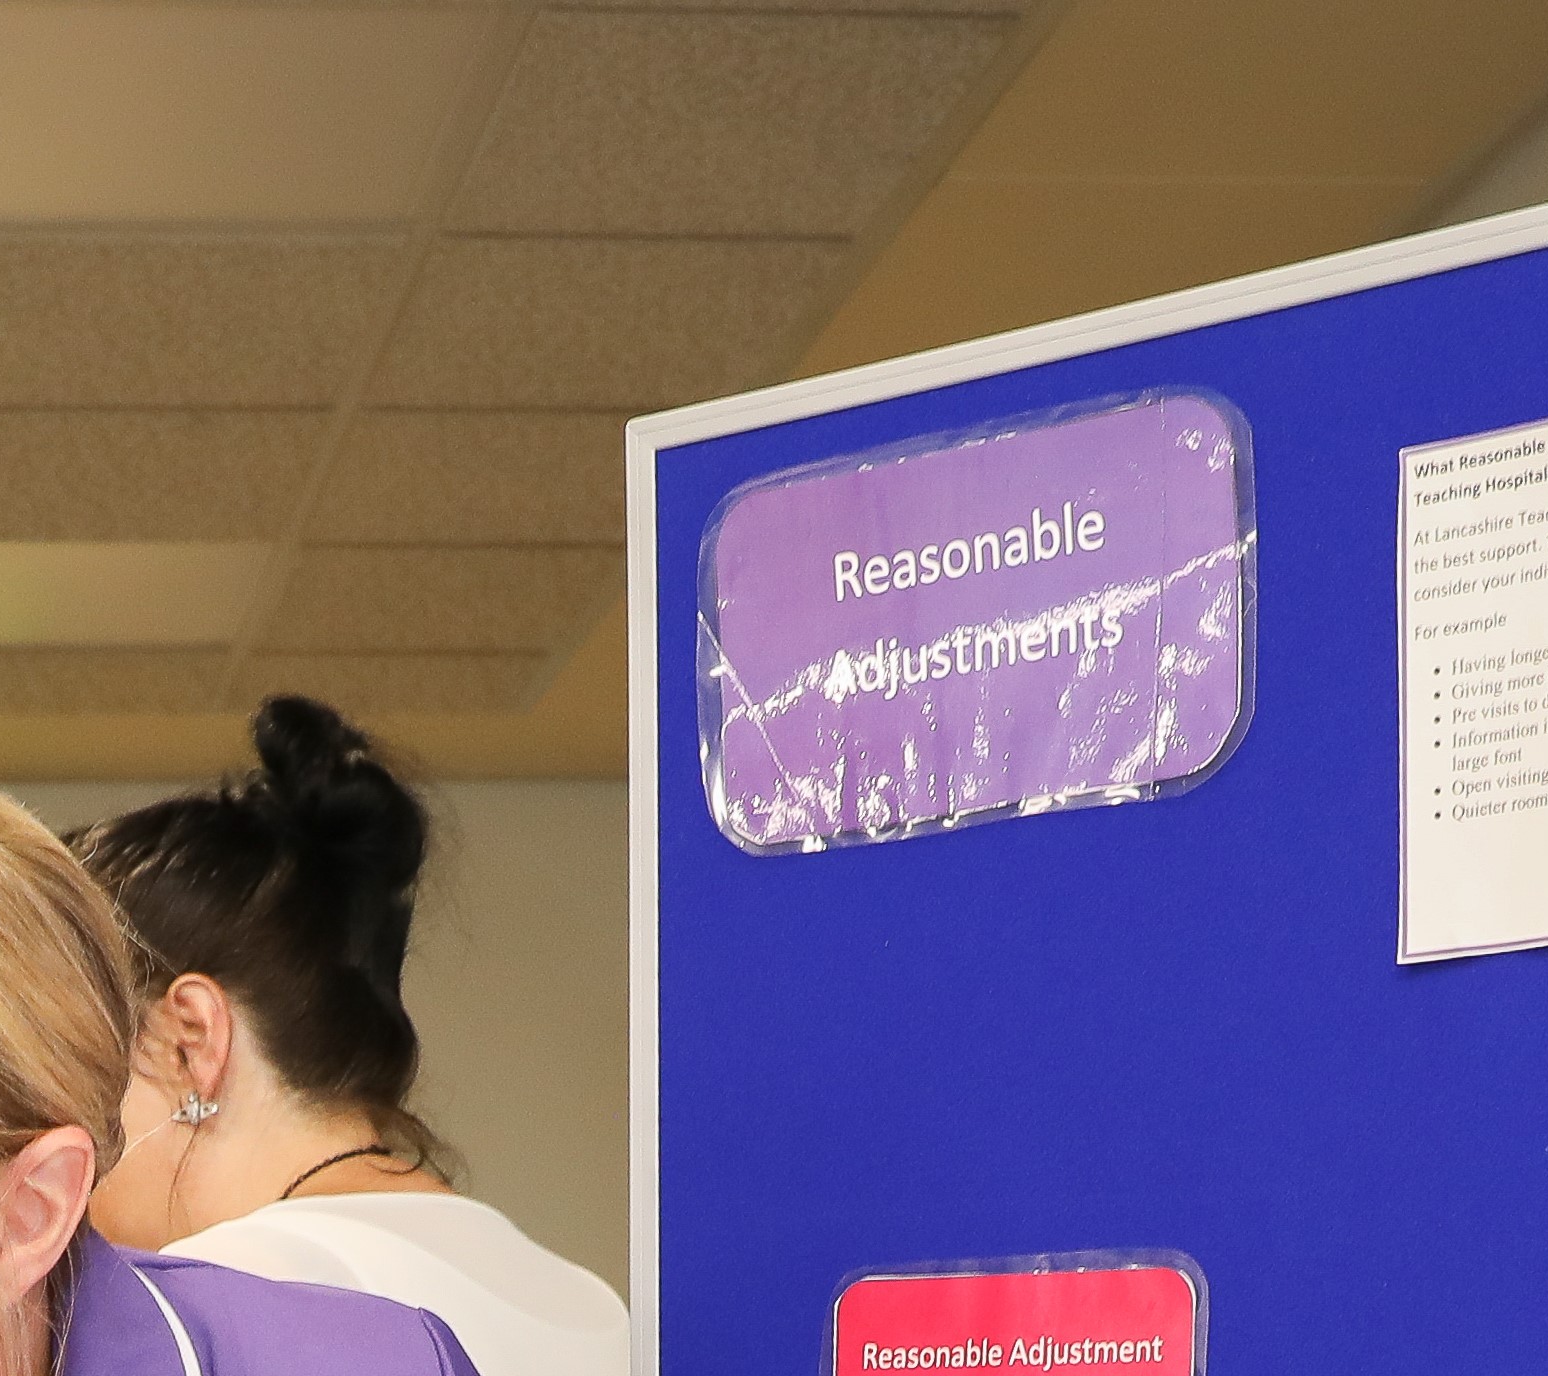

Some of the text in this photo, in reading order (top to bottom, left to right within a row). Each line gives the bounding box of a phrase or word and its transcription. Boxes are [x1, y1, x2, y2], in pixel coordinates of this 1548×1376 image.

[1413, 458, 1455, 480] What
[1459, 437, 1546, 471] Reasonable
[1414, 482, 1482, 508] Teaching
[834, 501, 1105, 601] Reasonable
[826, 605, 1124, 700] Adjustments
[863, 1335, 1163, 1373] Reasonable Adjustment
